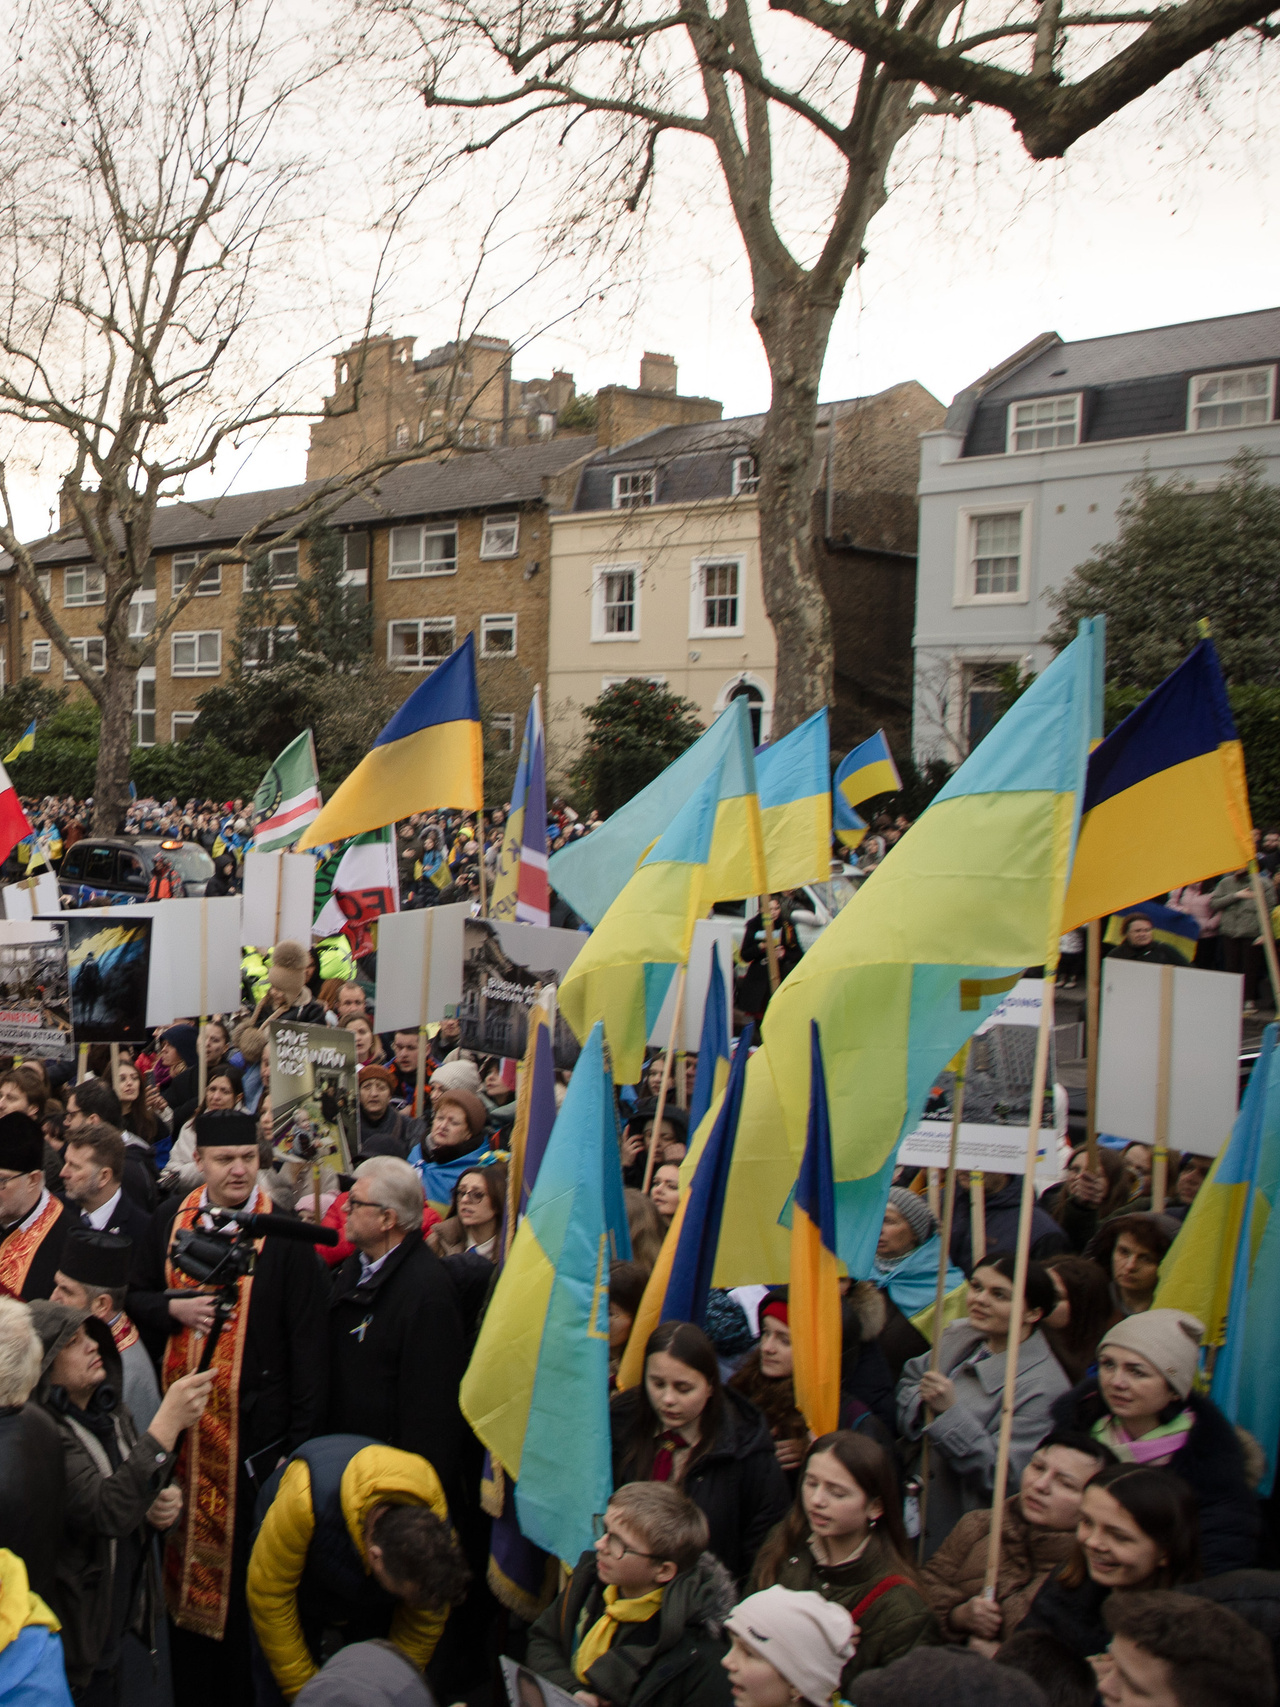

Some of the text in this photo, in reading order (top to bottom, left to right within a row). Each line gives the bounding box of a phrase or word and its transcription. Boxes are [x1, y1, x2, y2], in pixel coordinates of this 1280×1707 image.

[32, 1031, 65, 1040] ATTACK
[275, 1028, 310, 1046] SAVE
[276, 1059, 306, 1077] KIDS
